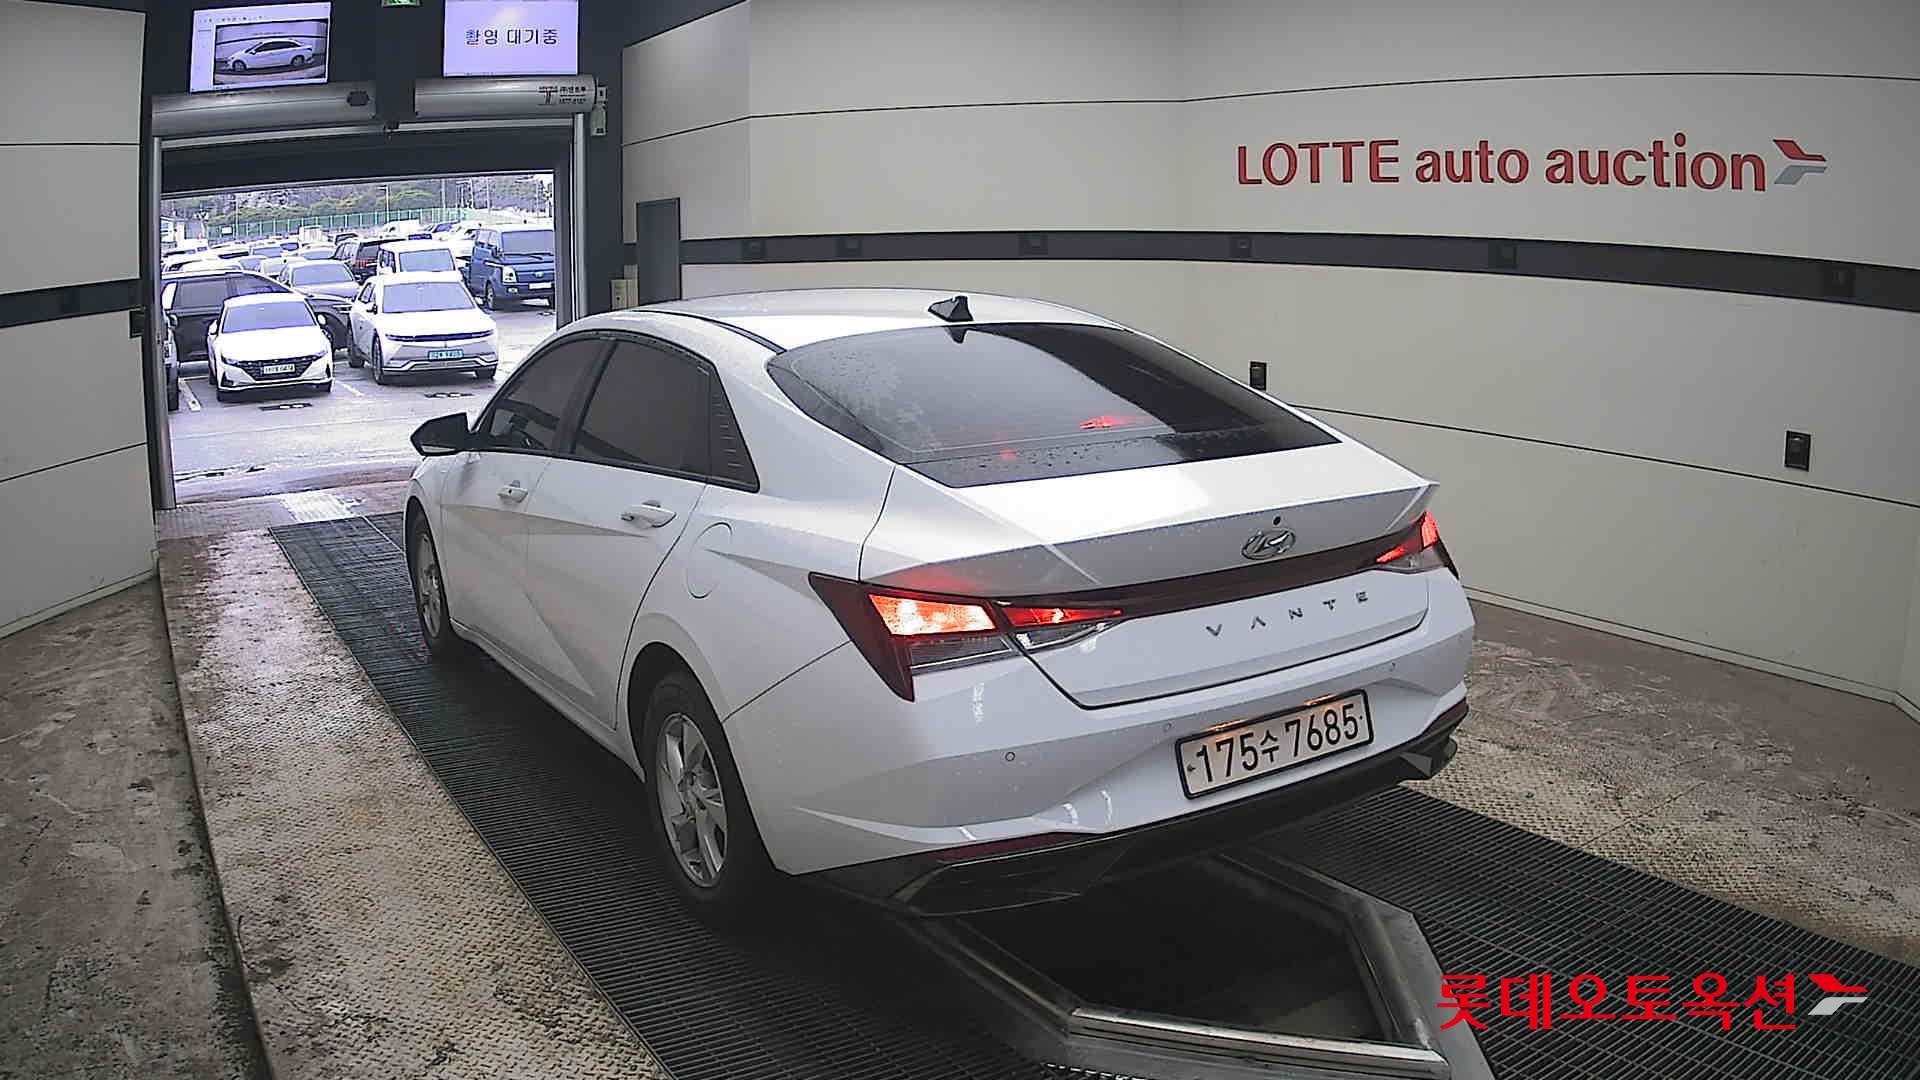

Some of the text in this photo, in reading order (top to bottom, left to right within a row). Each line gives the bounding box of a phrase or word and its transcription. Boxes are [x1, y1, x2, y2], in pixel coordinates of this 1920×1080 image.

[466, 29, 558, 46] 촬영 대기중
[1237, 132, 1767, 193] LOTTE auto auction
[1205, 591, 1369, 637] VANTE
